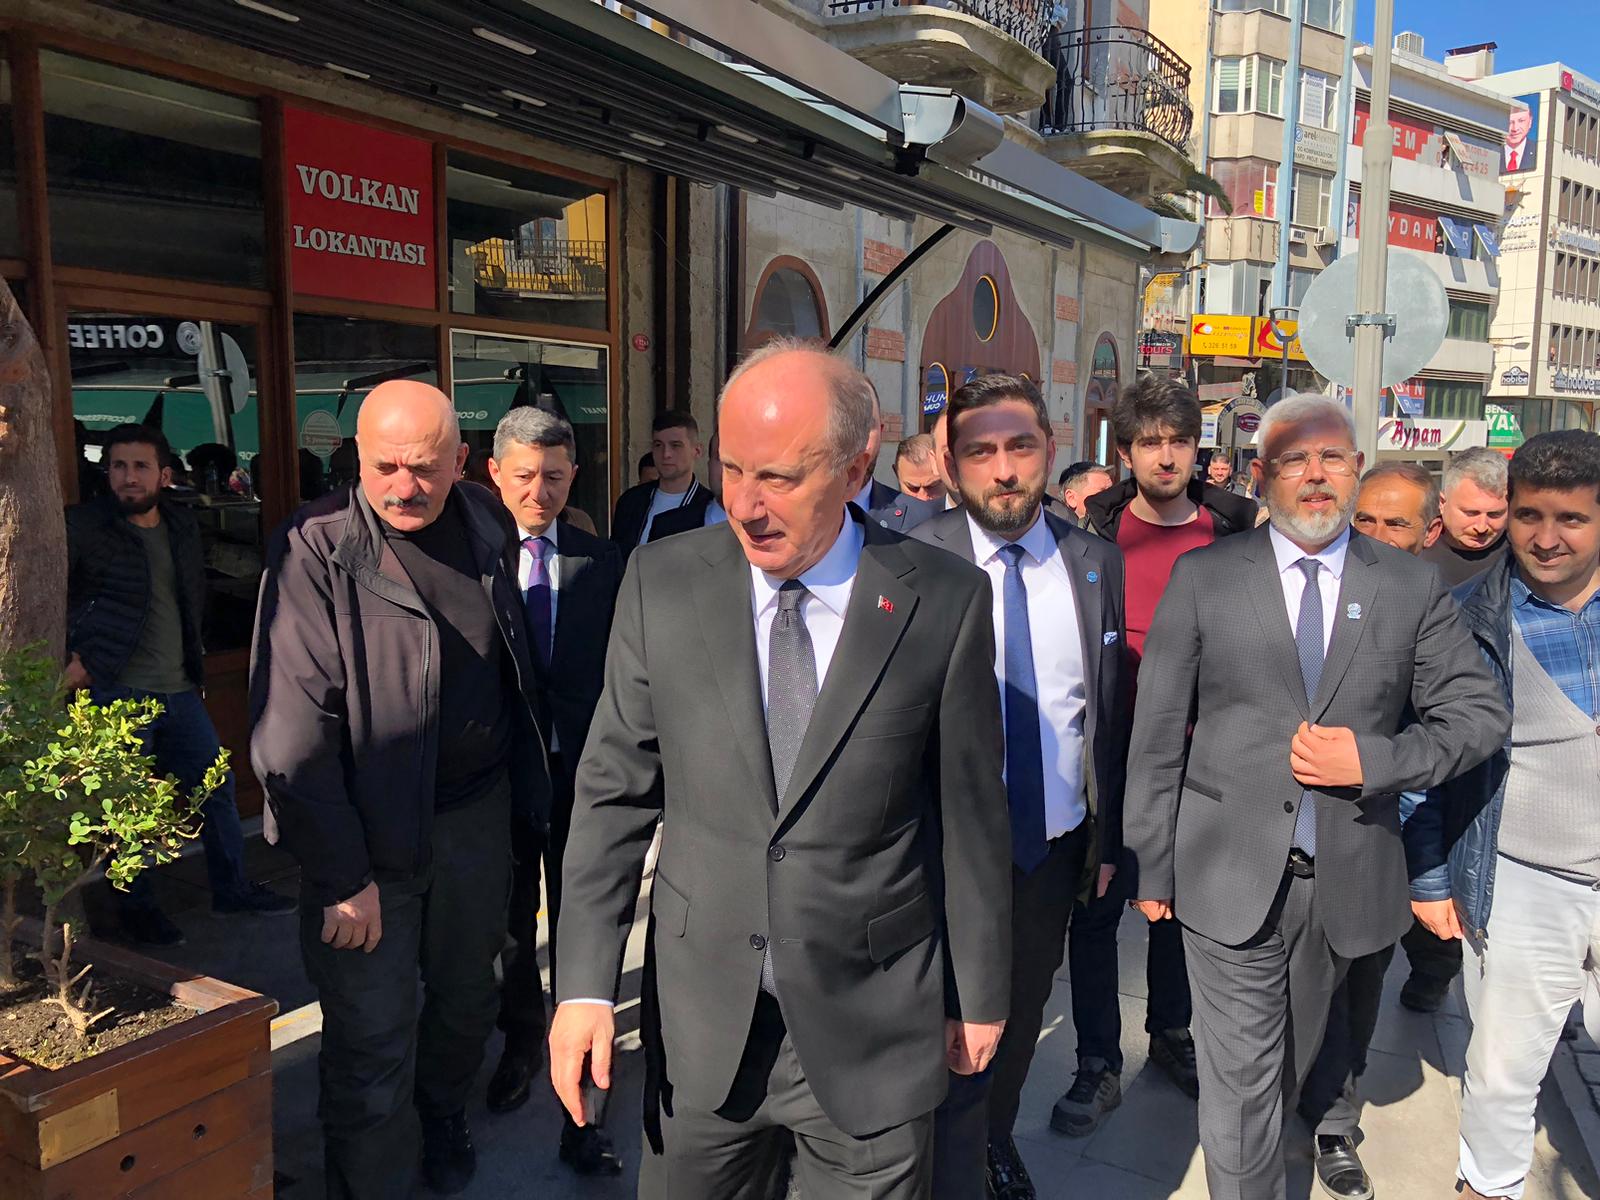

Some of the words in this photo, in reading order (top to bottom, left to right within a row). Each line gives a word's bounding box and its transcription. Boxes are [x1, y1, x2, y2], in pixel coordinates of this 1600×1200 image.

[296, 164, 419, 215] VOLKAN
[293, 225, 426, 266] LOKANTASI
[1391, 420, 1442, 449] Aypam
